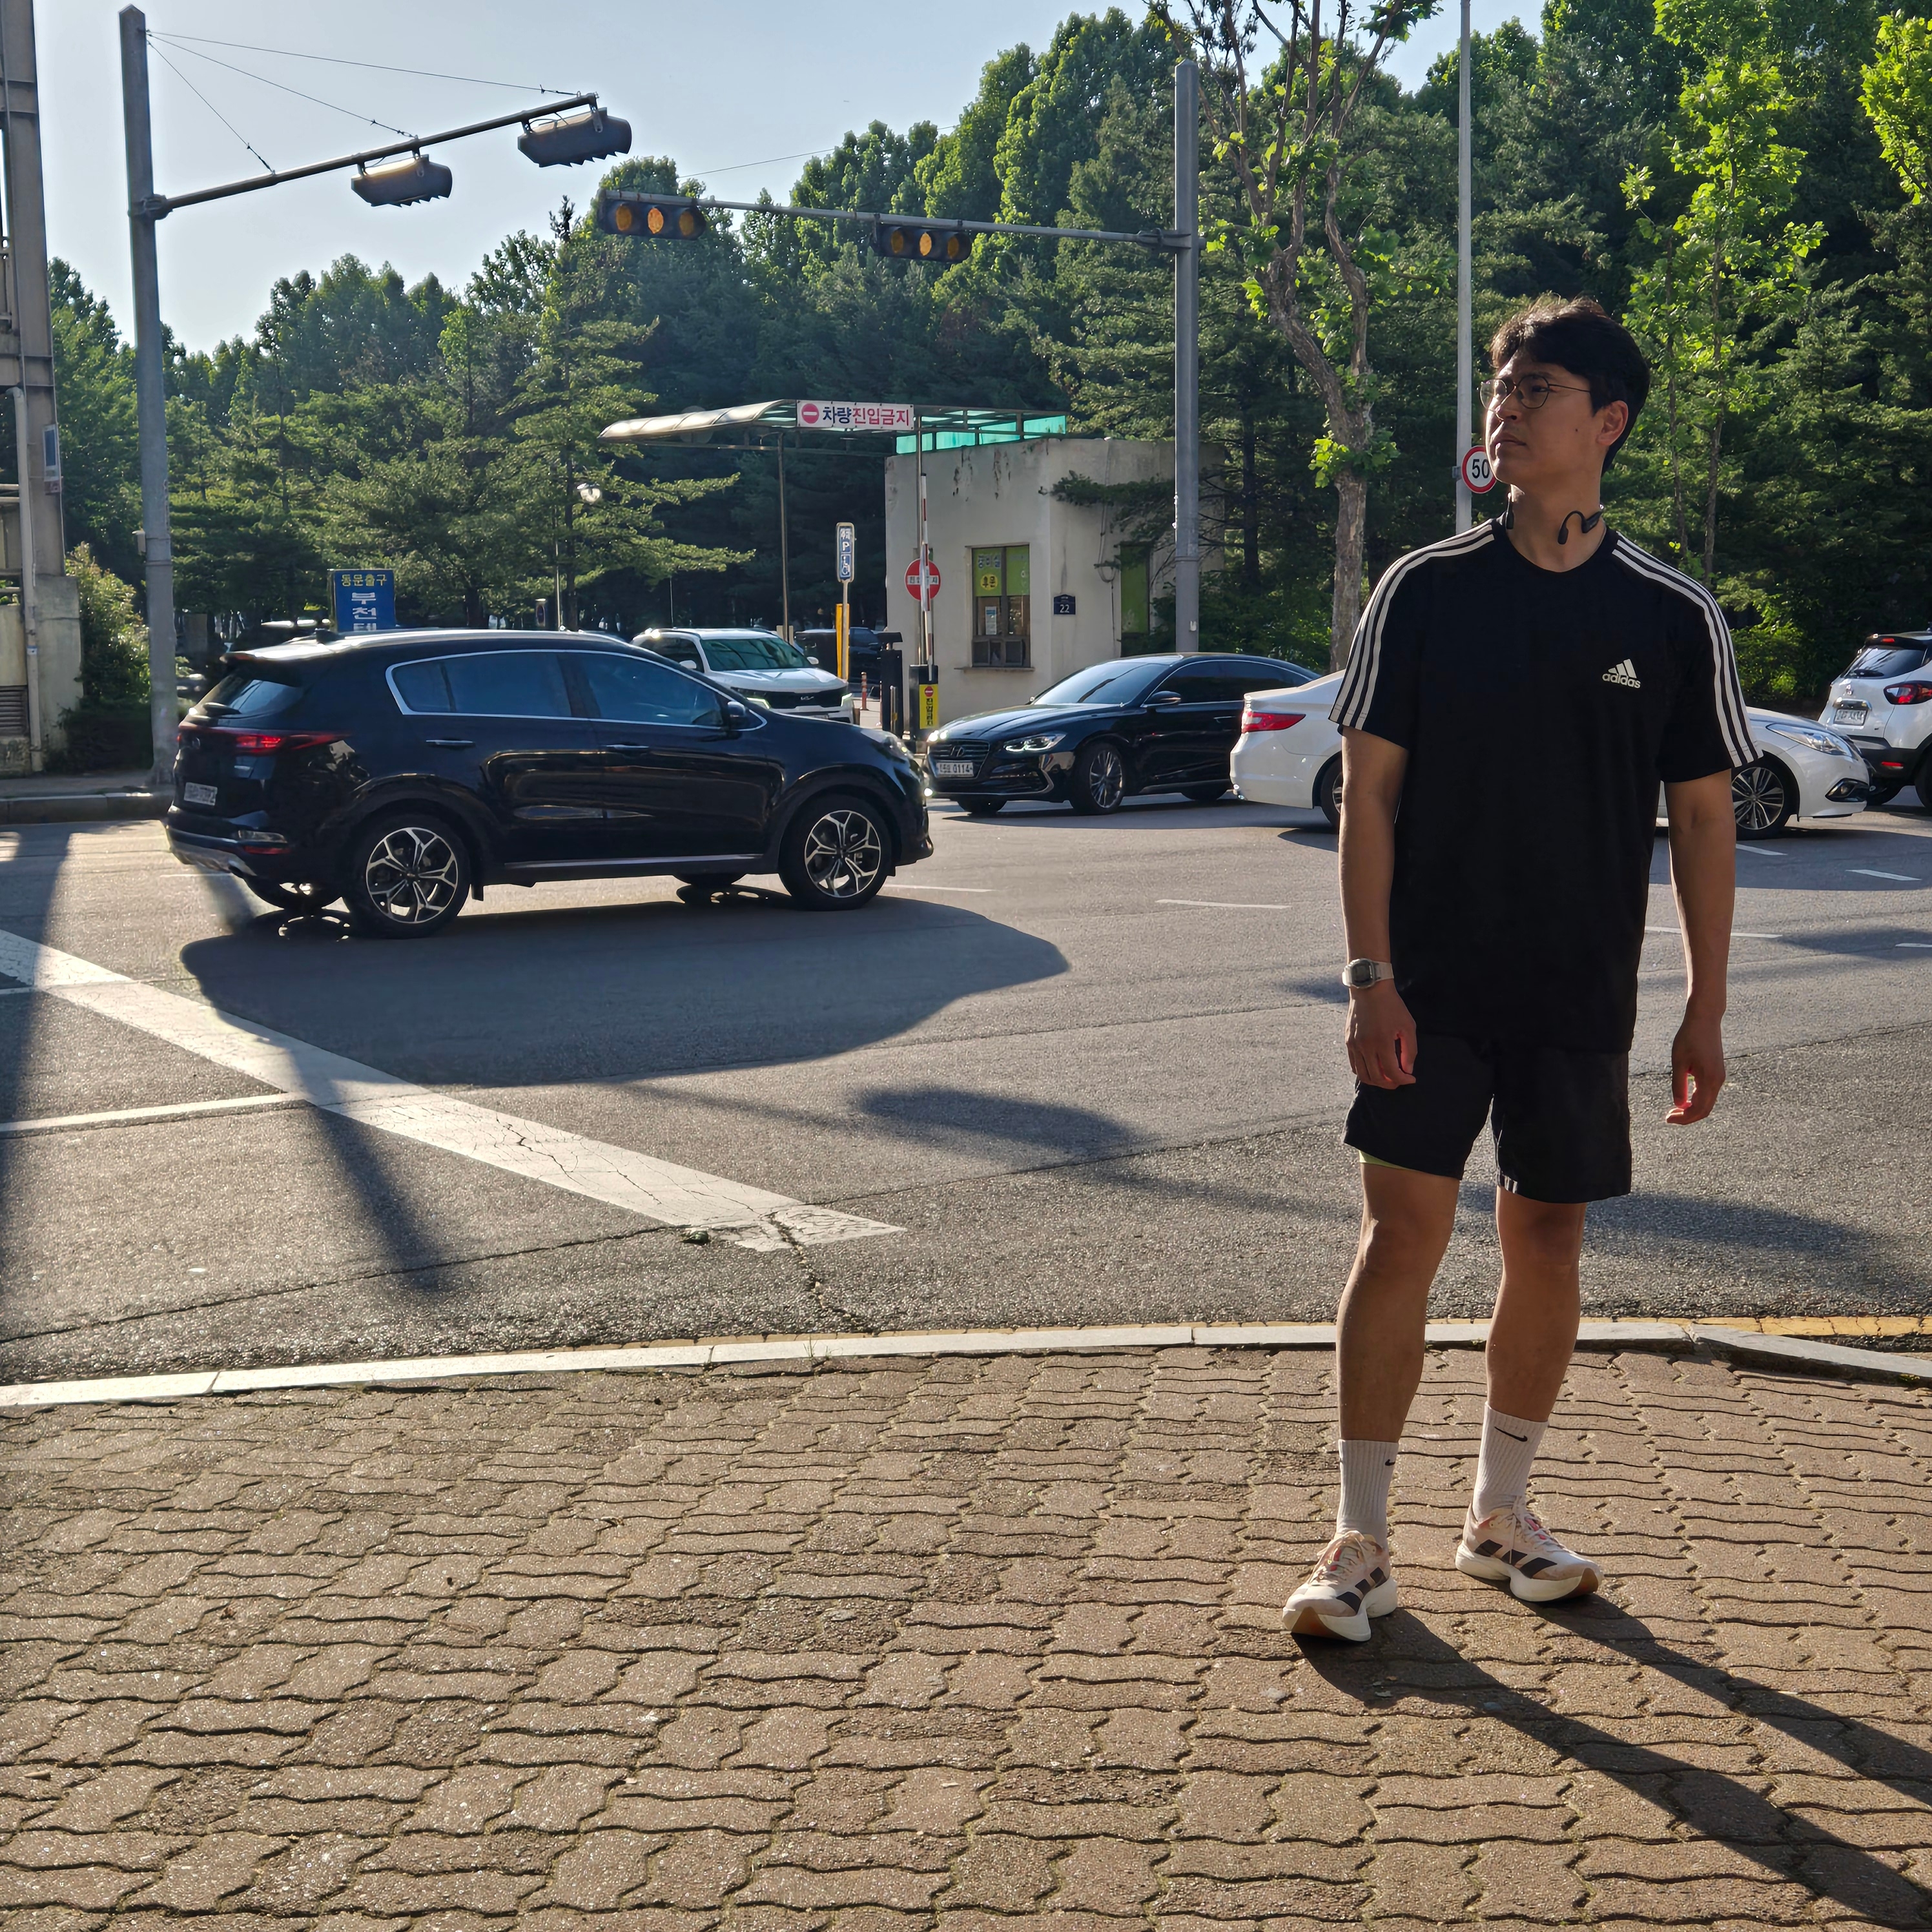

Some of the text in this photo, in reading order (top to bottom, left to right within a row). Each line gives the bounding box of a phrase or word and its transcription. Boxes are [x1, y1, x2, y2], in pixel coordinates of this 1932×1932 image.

[823, 406, 909, 426] 차량진입금지
[1472, 458, 1490, 479] 50
[1060, 604, 1070, 613] 22
[1602, 673, 1641, 689] adidas
